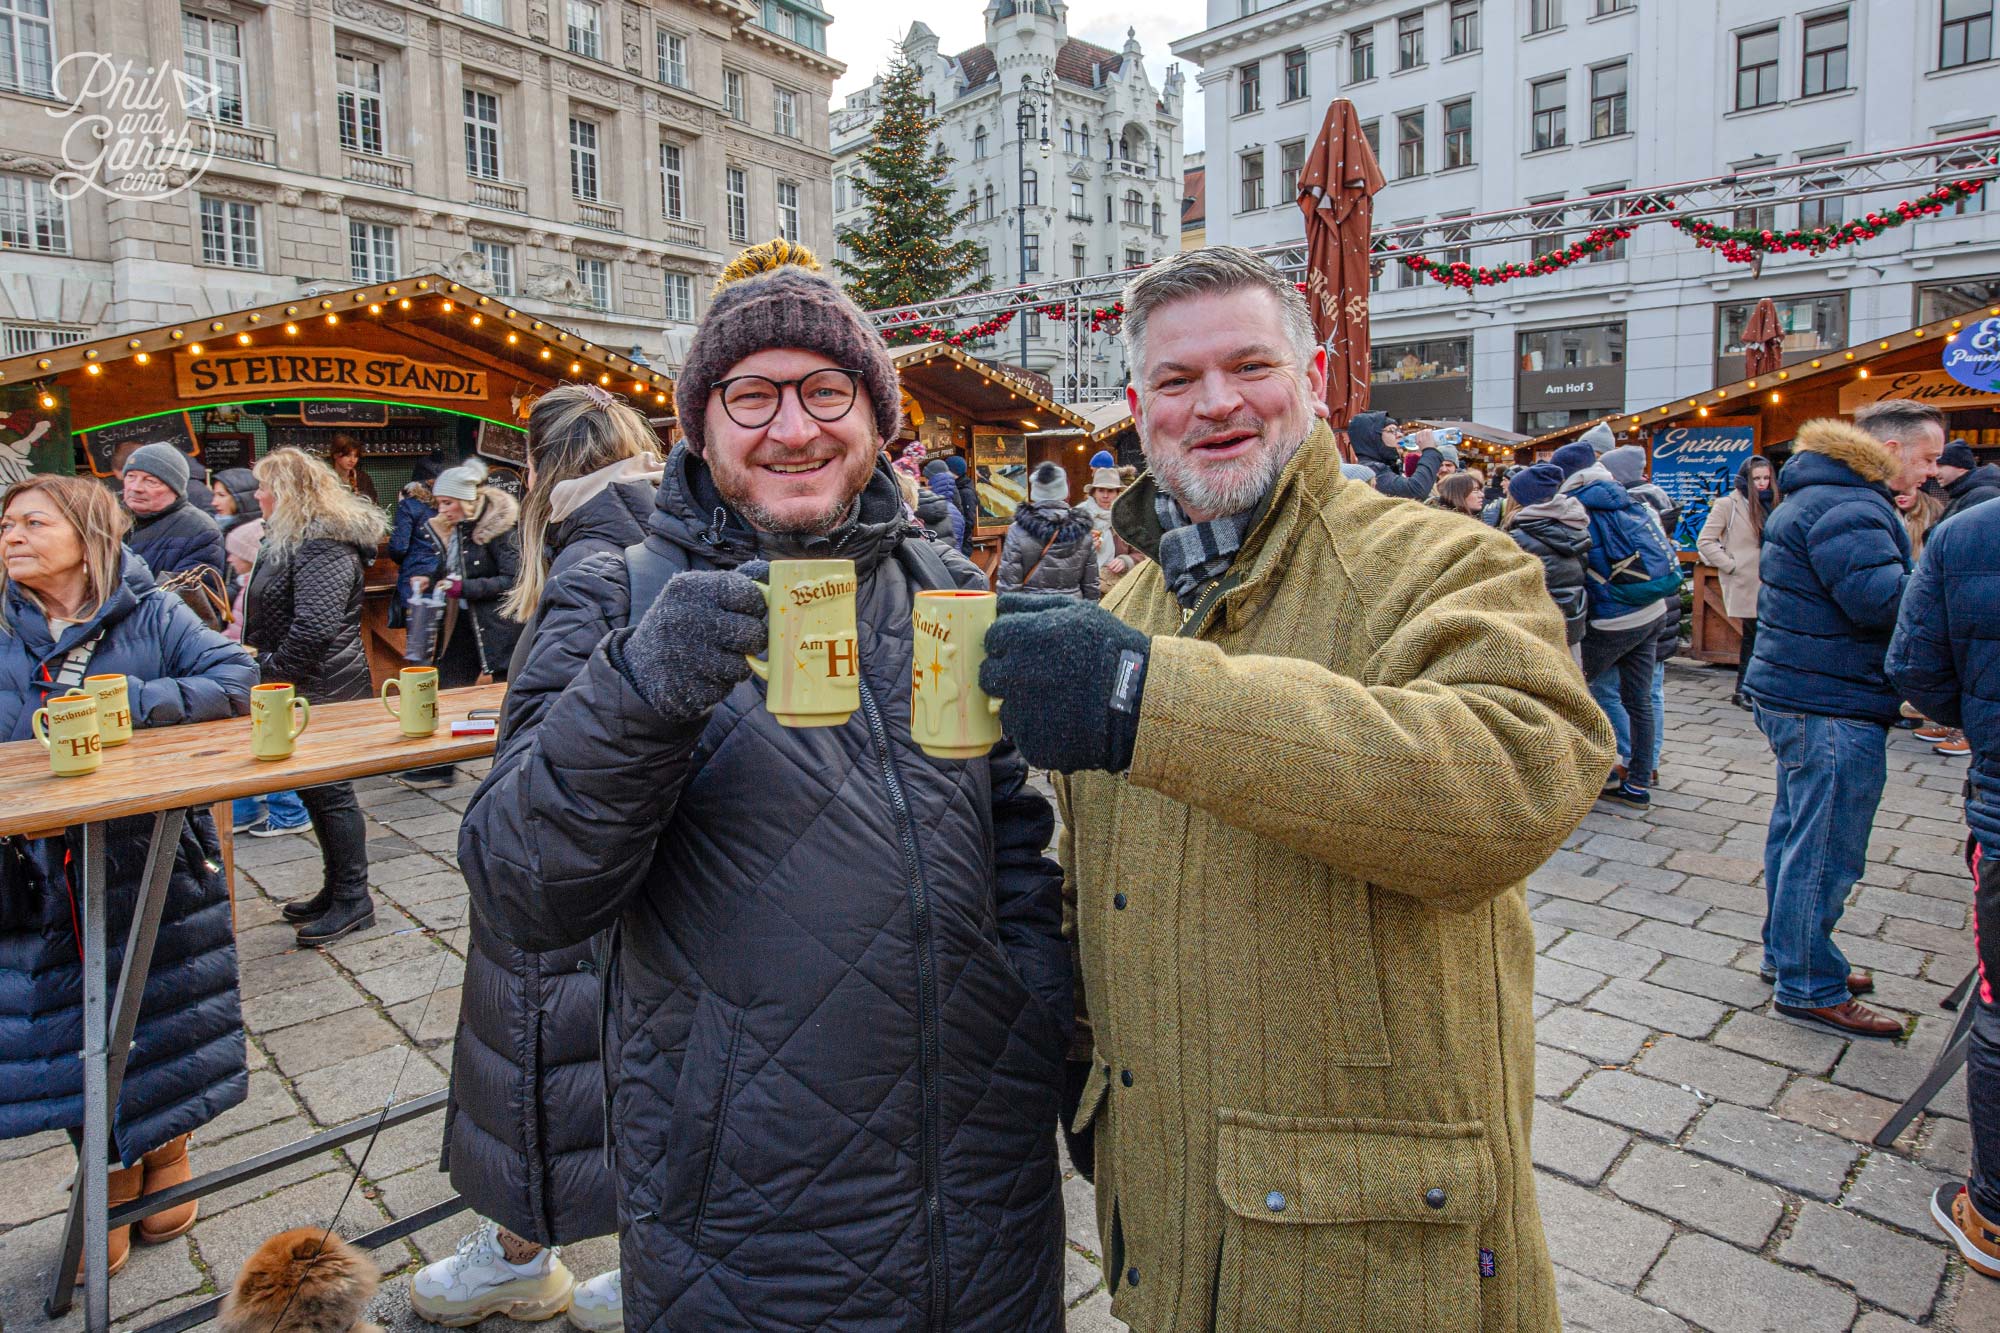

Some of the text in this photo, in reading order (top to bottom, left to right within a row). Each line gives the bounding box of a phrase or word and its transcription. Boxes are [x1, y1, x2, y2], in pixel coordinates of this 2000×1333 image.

[1970, 317, 2000, 349] E
[190, 355, 481, 396] STEIRER STANDL
[1545, 381, 1594, 394] Am Hof 3
[1653, 428, 1753, 459] Enzian
[825, 638, 859, 678] H
